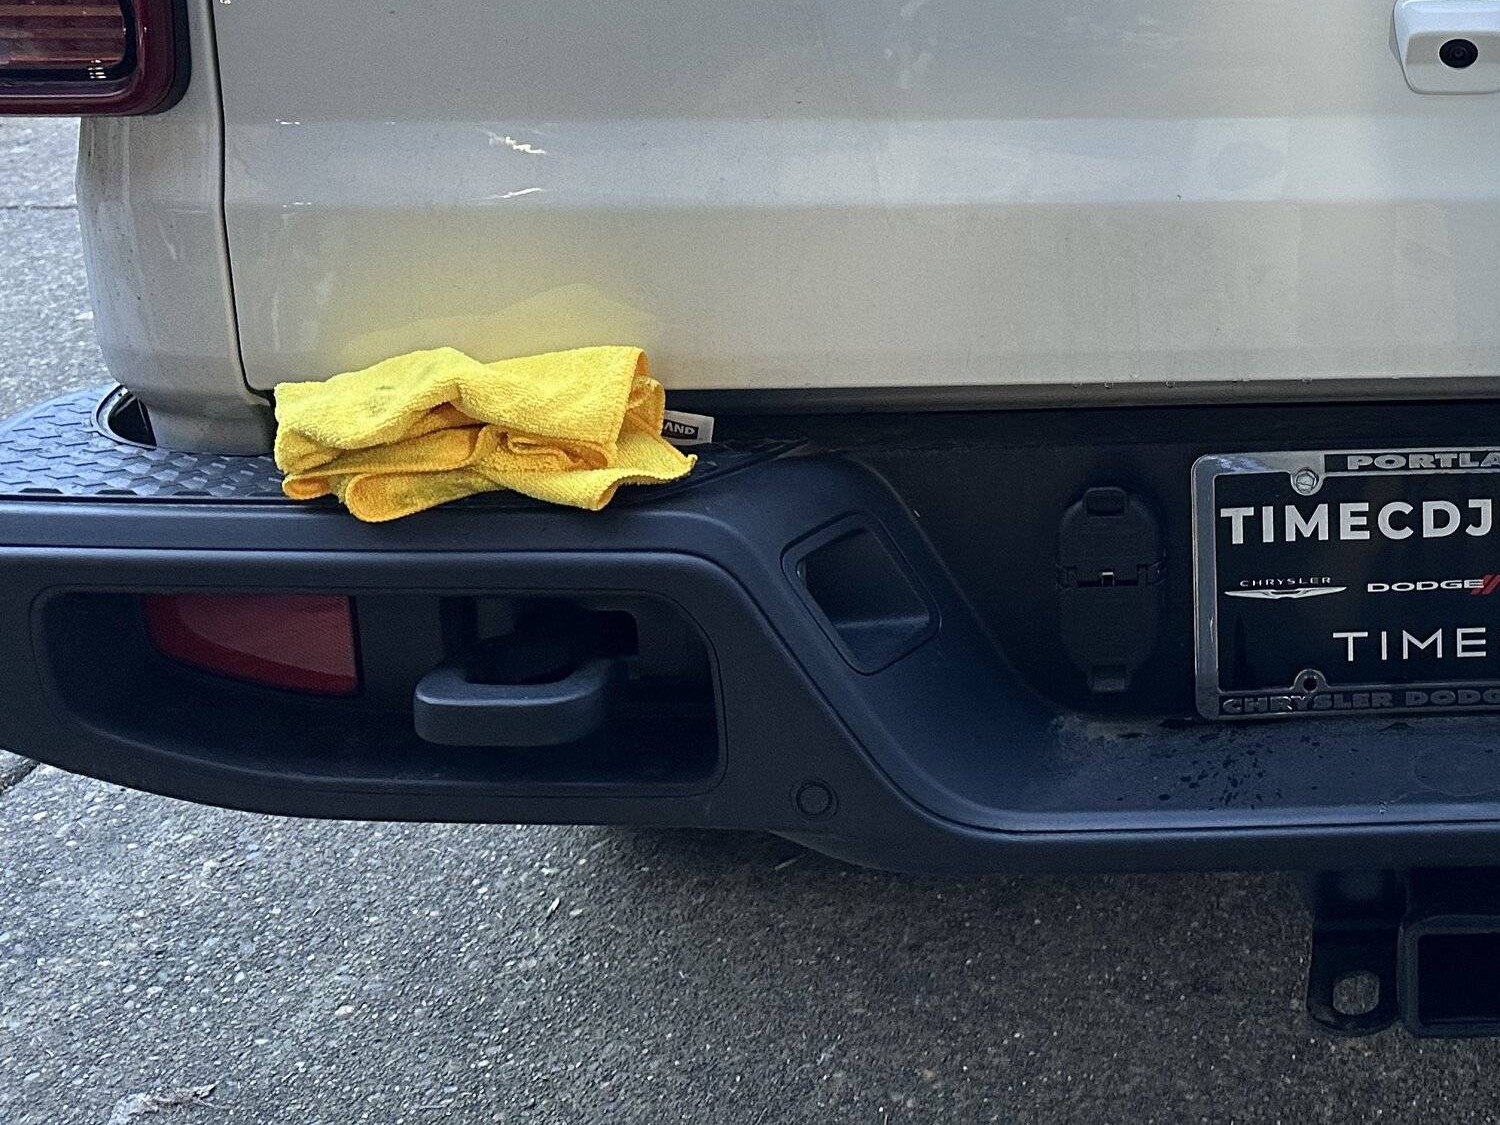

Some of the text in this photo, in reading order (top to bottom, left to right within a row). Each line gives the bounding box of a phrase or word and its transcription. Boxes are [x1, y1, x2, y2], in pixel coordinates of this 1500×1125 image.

[1239, 576, 1332, 587] CHRYSLER
[1367, 579, 1485, 593] DODGE
[1332, 627, 1487, 662] TIME
[1222, 691, 1393, 714] CHRYSLER
